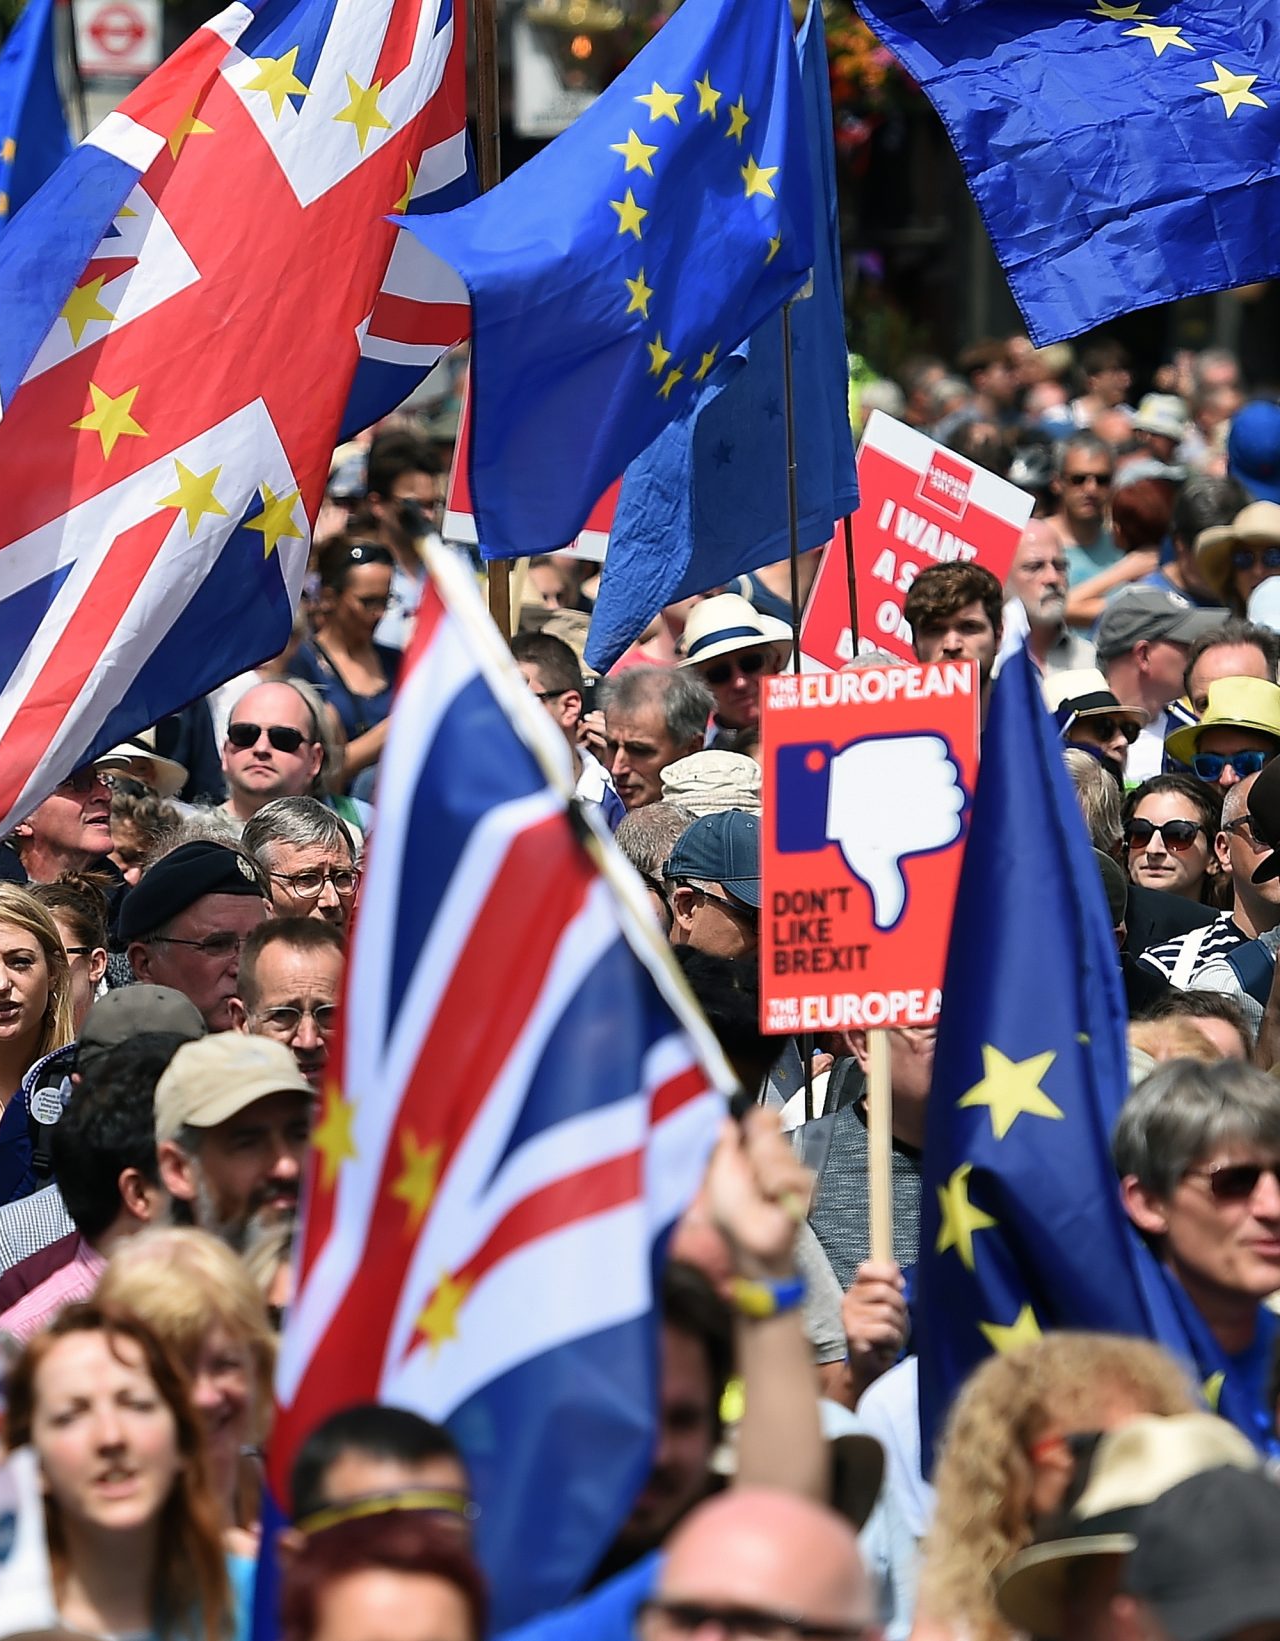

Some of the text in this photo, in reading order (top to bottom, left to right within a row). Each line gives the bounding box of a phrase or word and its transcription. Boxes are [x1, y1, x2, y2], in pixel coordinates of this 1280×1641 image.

[877, 498, 979, 564] I WANT
[871, 549, 920, 594] A S
[768, 693, 801, 709] NEW
[769, 677, 798, 695] THE
[801, 663, 973, 708] EUROPEAN
[773, 886, 852, 917] DON'T
[773, 917, 833, 946] LIKE
[773, 944, 871, 976] BREXIT
[768, 1013, 801, 1030] NEW
[769, 998, 799, 1015] THE
[801, 988, 942, 1028] EUROPEA
